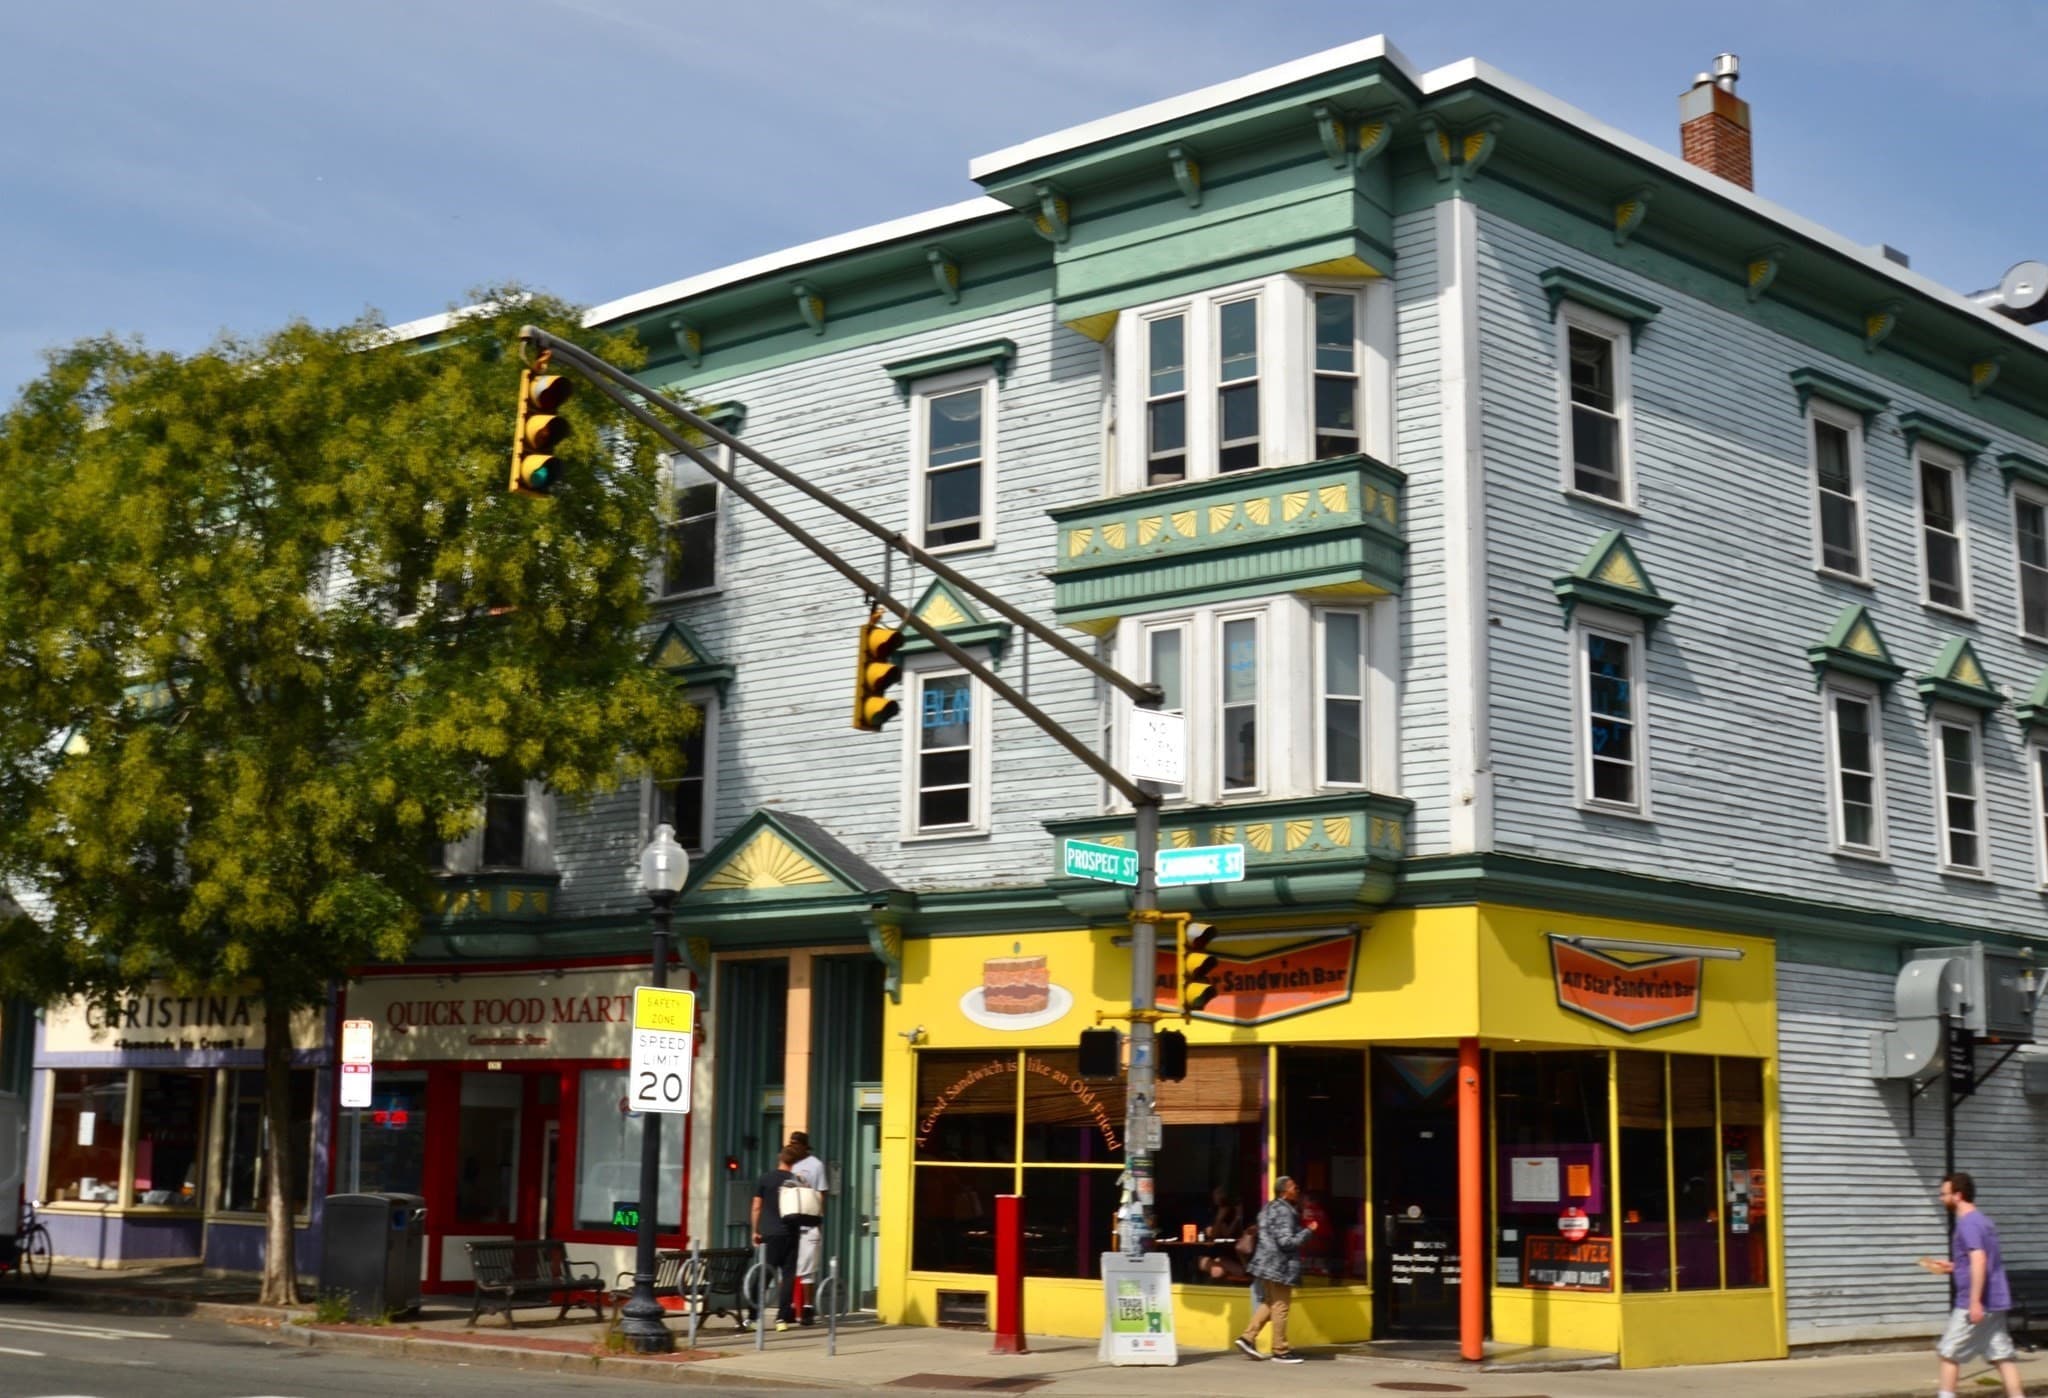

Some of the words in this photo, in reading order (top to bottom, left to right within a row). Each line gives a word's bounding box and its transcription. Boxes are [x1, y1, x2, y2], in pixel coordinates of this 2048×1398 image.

[1067, 847, 1119, 876] PROSPECT
[1122, 856, 1137, 878] ST
[1223, 968, 1309, 992] Sandwich
[1312, 966, 1346, 984] Bar
[1562, 971, 1583, 988] All
[1584, 973, 1611, 995] Star
[1614, 975, 1673, 998] Sandwich
[387, 1000, 464, 1033] QUICK
[473, 998, 545, 1025] FOOD
[551, 996, 632, 1024] MART
[648, 998, 680, 1009] SAFETY
[651, 1014, 676, 1025] ZONE
[639, 1035, 686, 1050] SPEED
[643, 1055, 680, 1066] LIMIT
[639, 1071, 682, 1102] 20
[920, 1096, 948, 1133] Good
[945, 1060, 1004, 1100] Sandwich
[1026, 1057, 1051, 1076] like
[1052, 1070, 1069, 1085] an
[1071, 1079, 1096, 1105] Old
[1091, 1101, 1122, 1151] Friend
